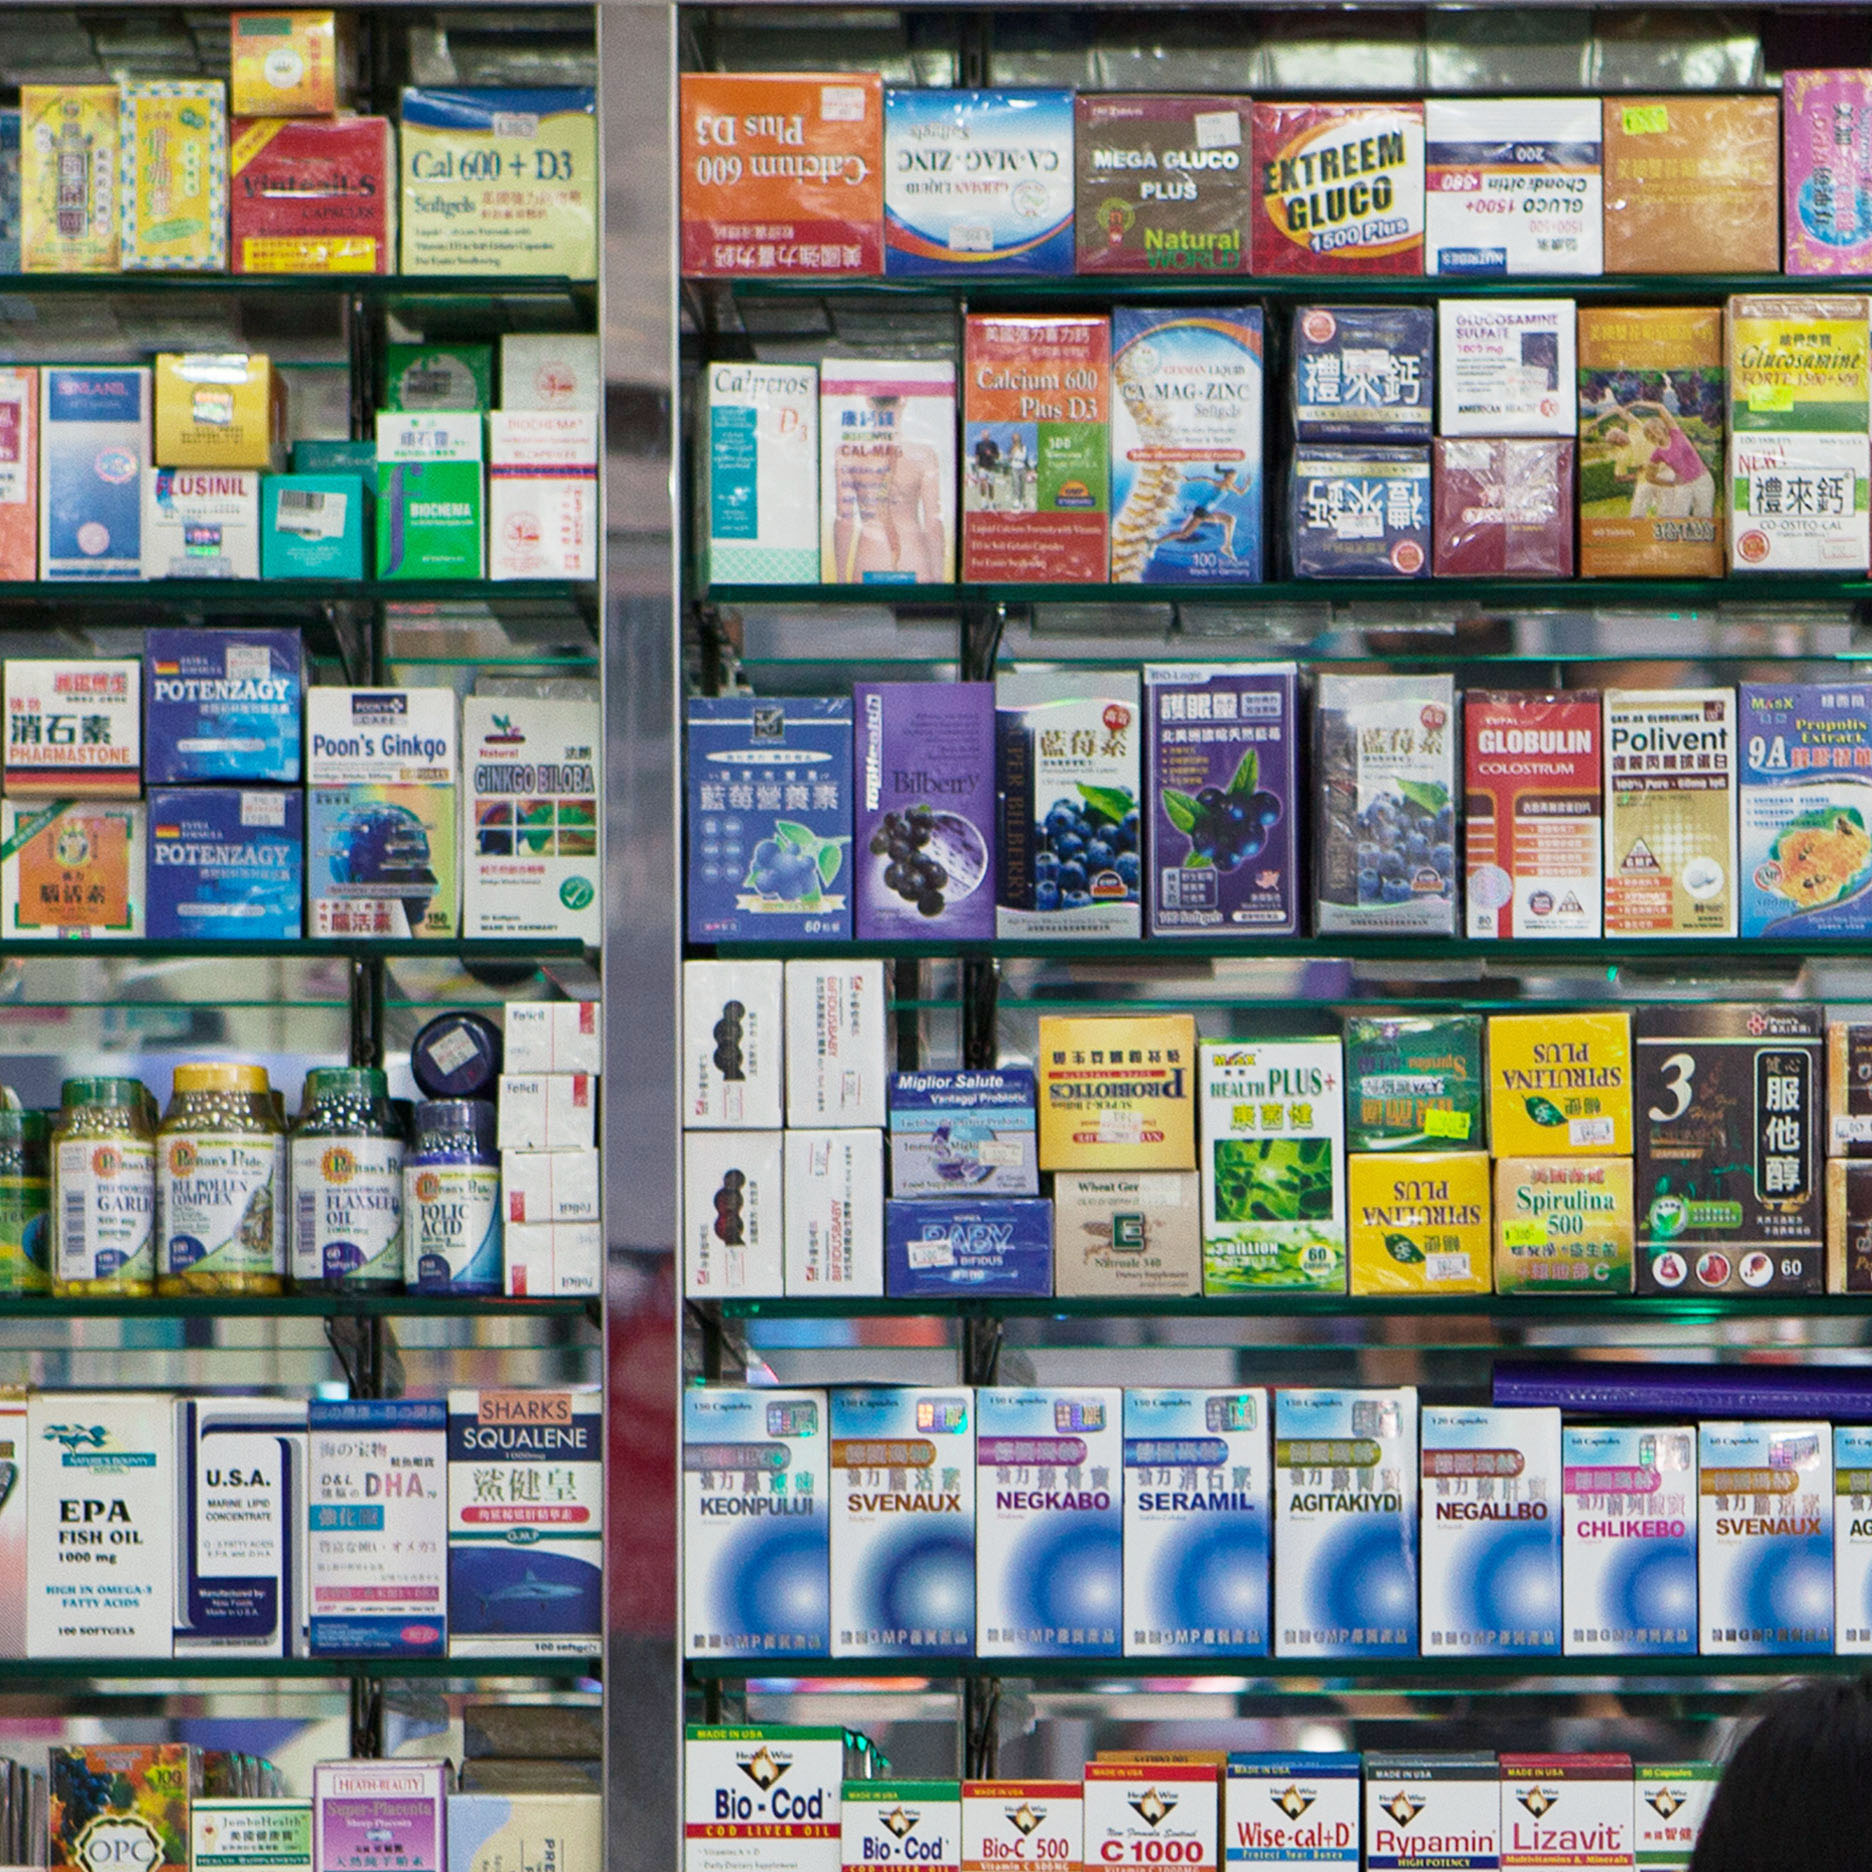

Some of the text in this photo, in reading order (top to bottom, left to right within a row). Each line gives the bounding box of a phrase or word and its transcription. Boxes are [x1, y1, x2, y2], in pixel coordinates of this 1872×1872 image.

[697, 113, 803, 150] Plus D3
[412, 152, 452, 181] Cal
[459, 150, 500, 181] 600
[536, 150, 574, 180] D3
[698, 152, 868, 186] Calcium 600
[1094, 149, 1239, 171] MEGA GLUCO
[1263, 131, 1406, 194] EXTREEM
[1140, 181, 1198, 201] PLUS
[1286, 176, 1393, 231] GLUCO
[1145, 228, 1240, 252] Natural
[1310, 215, 1409, 254] 1500 Plus
[1146, 249, 1240, 269] WORLD
[1740, 344, 1862, 370] Glucosamine
[976, 369, 1099, 392] Calcium 600
[1020, 398, 1099, 420] Plus D3
[409, 502, 471, 519] BIOCHEMA
[155, 679, 291, 701] POTENZAGY
[10, 715, 112, 745] 消石素
[1478, 729, 1592, 753] GLOBULIN
[1612, 728, 1727, 751] Polivent
[9, 747, 130, 765] PHARMASTONE
[312, 734, 447, 759] Poon's Ginkgo
[1749, 738, 1787, 769] 9A
[1478, 762, 1574, 775] COLOSTRUM
[894, 770, 979, 796] Bilberry
[1533, 1042, 1589, 1062] PLUS
[1504, 1066, 1622, 1089] SPIRULINA
[1516, 1187, 1614, 1212] Spirulina
[1547, 1214, 1584, 1236] 500
[481, 1401, 569, 1422] SHARKS
[464, 1428, 587, 1451] SQUALENE
[206, 1469, 272, 1488] U.S.A.
[59, 1499, 132, 1524] EPA
[207, 1499, 270, 1508] MARINE LIPID
[847, 1493, 962, 1513] SVENAUX
[996, 1490, 1110, 1511] NEGKABO
[1138, 1491, 1254, 1512] SERAMIL
[1436, 1502, 1547, 1521] NEGALLBO
[206, 1512, 272, 1521] CONCENTRATE
[59, 1531, 142, 1546] FISH OIL
[1576, 1521, 1686, 1538] CHLIKEBO
[59, 1552, 117, 1565] 1000 mg
[1238, 1821, 1350, 1849] Wise-cal+D
[1376, 1831, 1494, 1860] Rypamin
[1513, 1822, 1620, 1851] Lizavit
[89, 1839, 152, 1865] OPC
[983, 1838, 1069, 1859] Bio-C 500
[1102, 1840, 1203, 1862] C 1000
